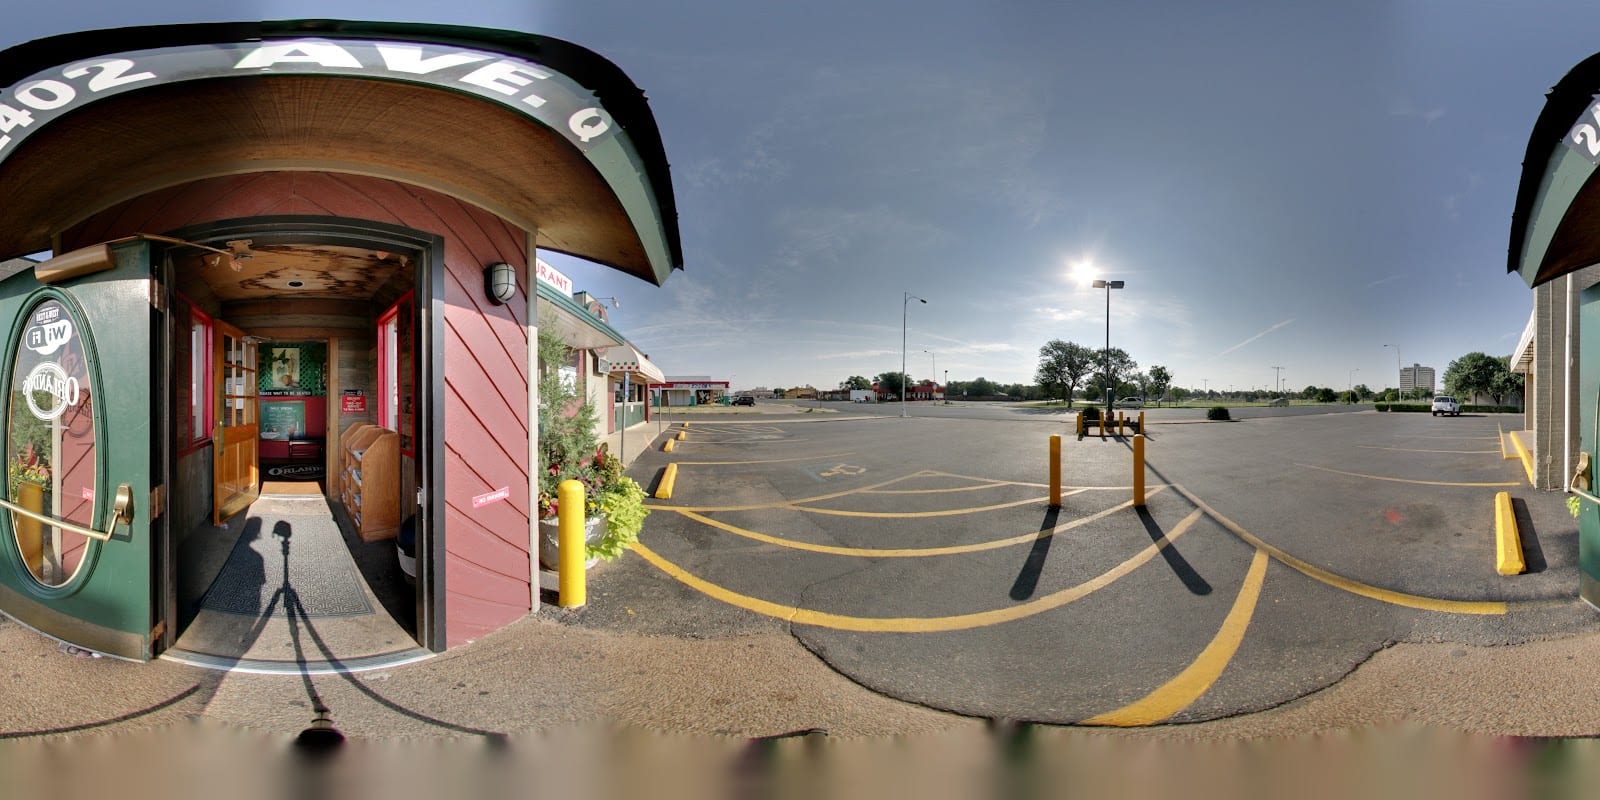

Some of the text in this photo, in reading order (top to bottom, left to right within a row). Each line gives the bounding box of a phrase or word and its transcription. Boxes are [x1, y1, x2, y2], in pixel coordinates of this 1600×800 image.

[0, 38, 613, 150] 402 AVE. Q
[1571, 102, 1600, 157] 2
